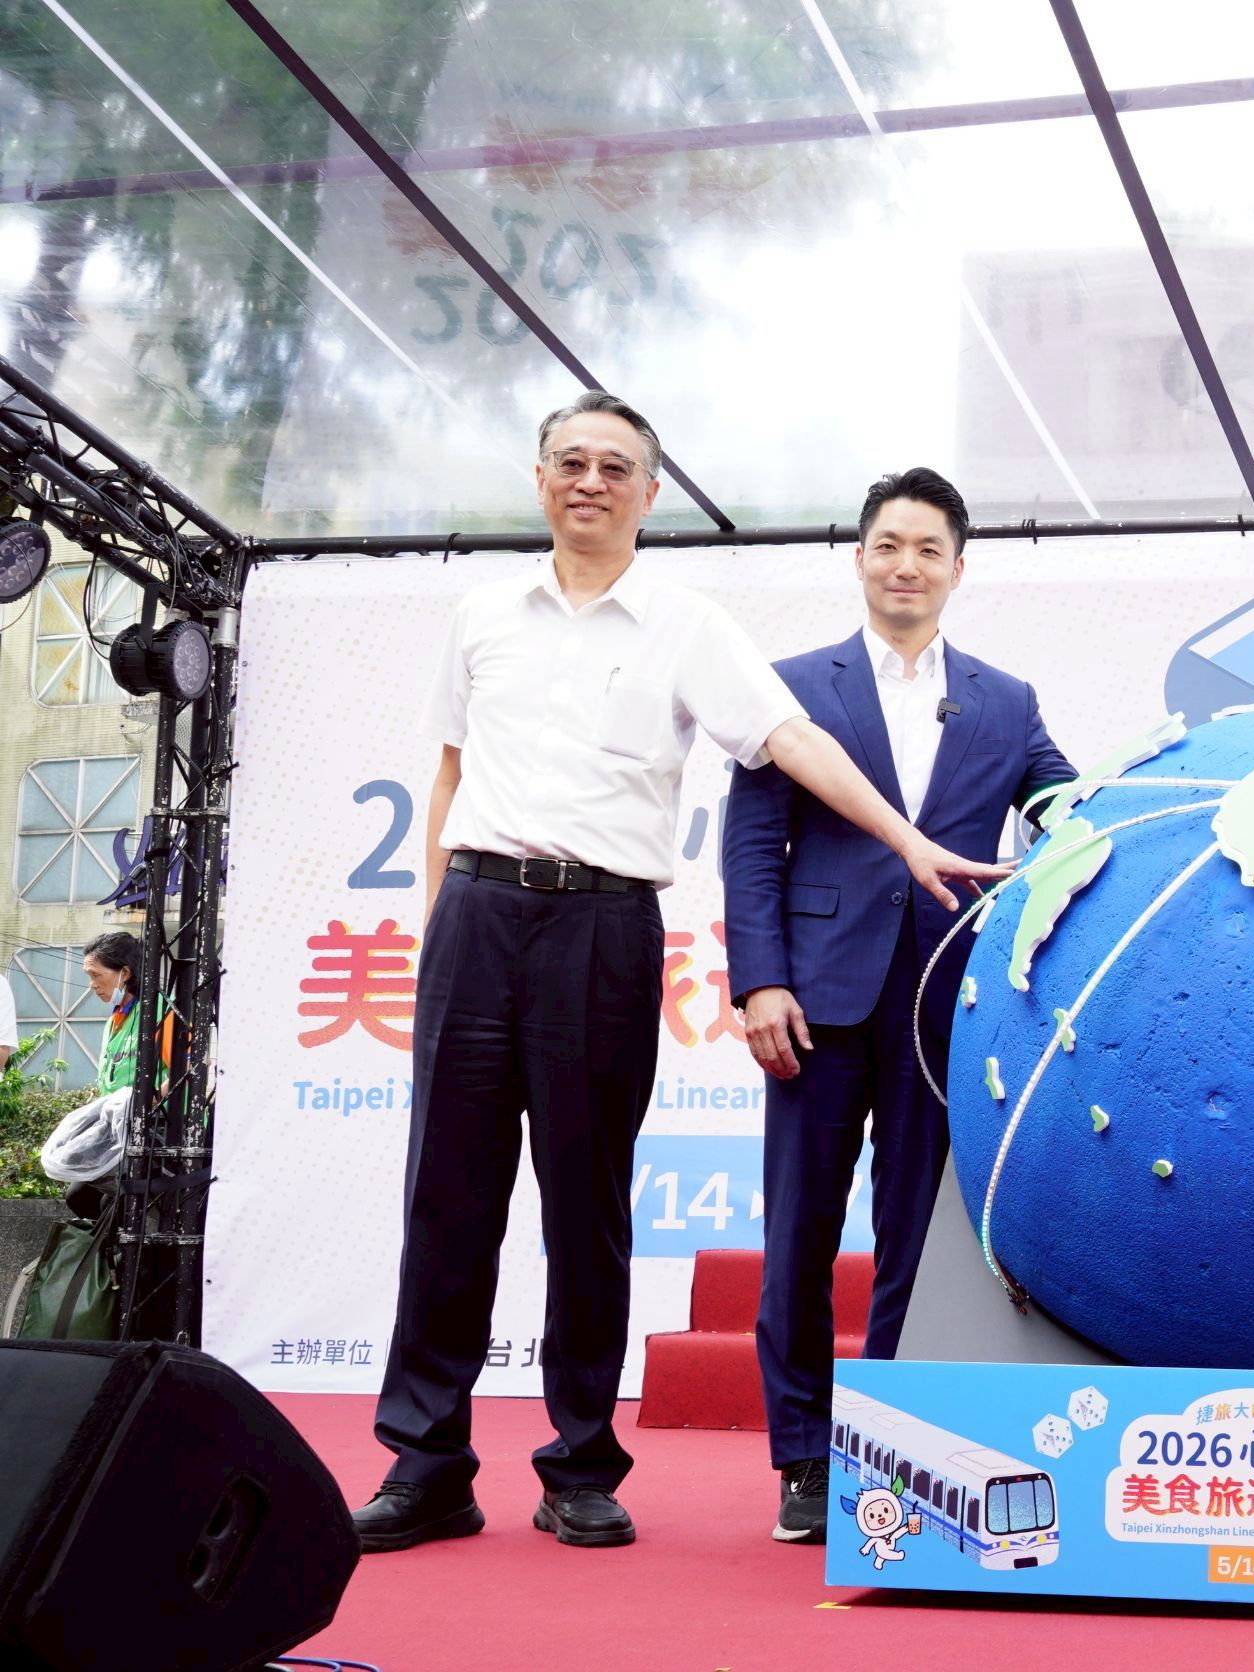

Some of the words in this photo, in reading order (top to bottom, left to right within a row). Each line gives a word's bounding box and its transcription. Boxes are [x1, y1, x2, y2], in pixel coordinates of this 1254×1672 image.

[293, 1077, 394, 1117] Taipei
[657, 1076, 765, 1111] Linear
[270, 1338, 374, 1366] 主辦單位
[1122, 1522, 1153, 1535] Taipei
[1155, 1523, 1230, 1538] Xinzhongshan
